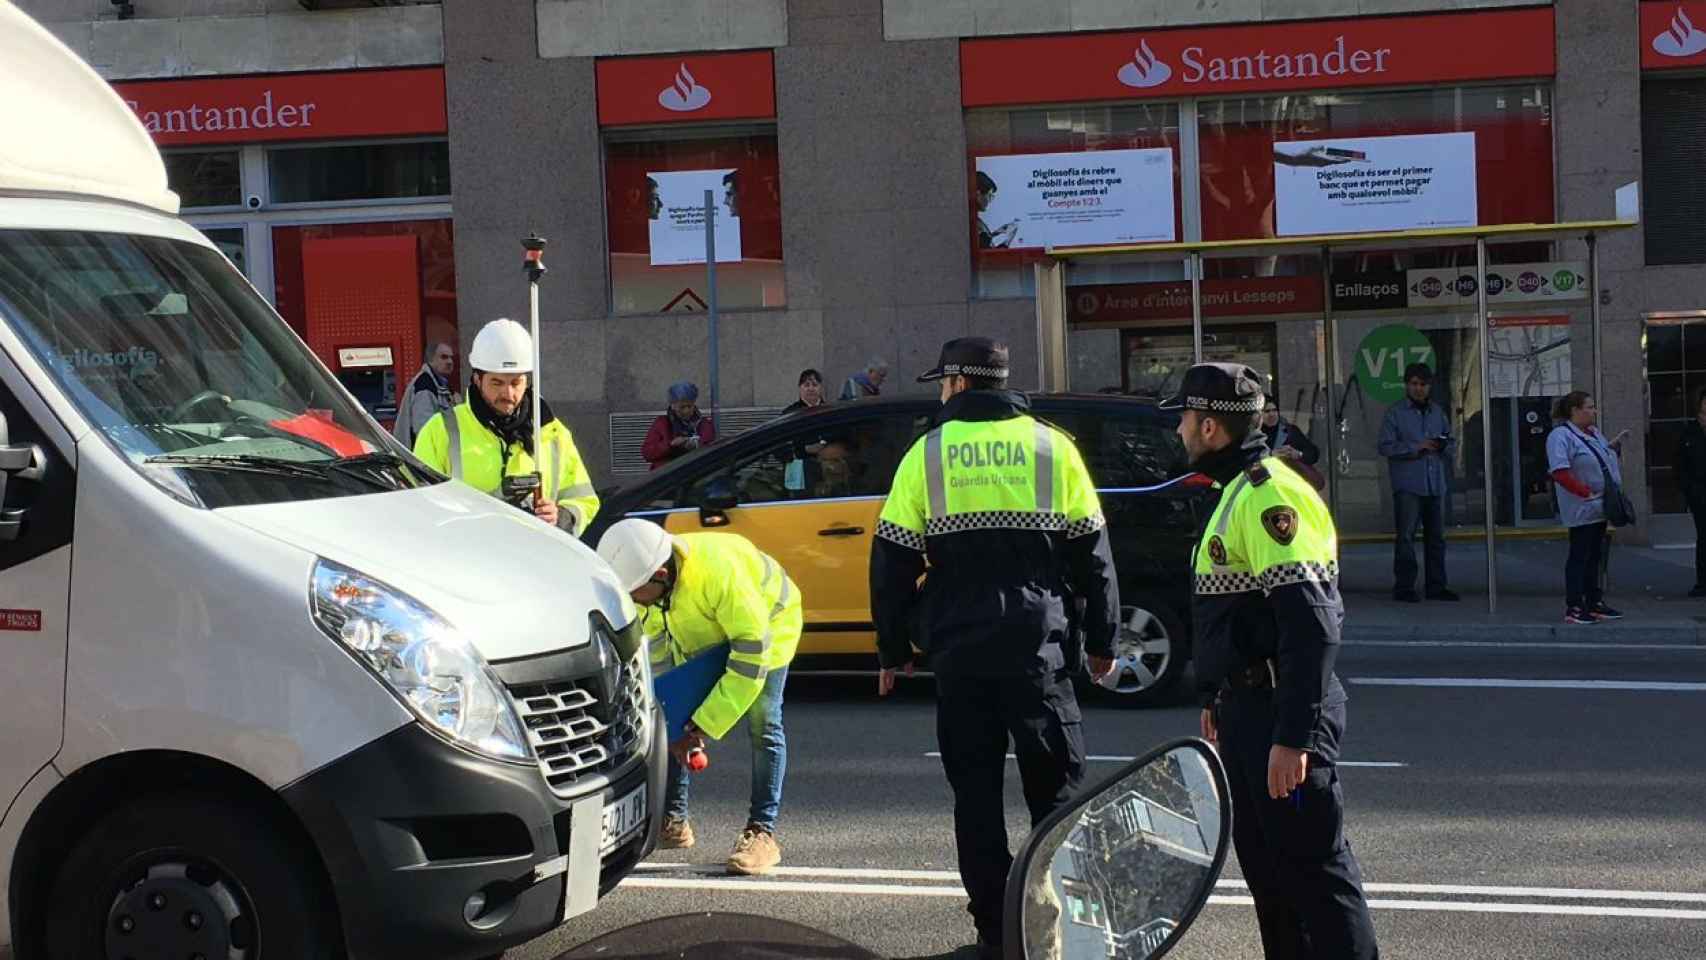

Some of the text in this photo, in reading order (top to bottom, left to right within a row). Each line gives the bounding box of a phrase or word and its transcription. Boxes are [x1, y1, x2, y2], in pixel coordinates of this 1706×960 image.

[1181, 35, 1391, 83] Santander
[1032, 166, 1116, 180] Digilosofia és rebre
[1316, 166, 1433, 181] Digilosofia és ser el primer
[1028, 176, 1122, 189] al mòbil els diners que
[1319, 177, 1431, 191] banc que et permet pagar
[1042, 186, 1108, 200] guanyes amb el
[1328, 190, 1347, 199] amb
[1348, 188, 1391, 200] qualsevol
[1047, 198, 1082, 209] Compte
[1335, 283, 1400, 299] Enllaços
[1143, 291, 1229, 308] d'interanvi
[1232, 289, 1296, 305] Lesseps
[1361, 346, 1432, 378] V17
[947, 441, 1026, 469] POLICIA
[991, 473, 1027, 486] Urbana
